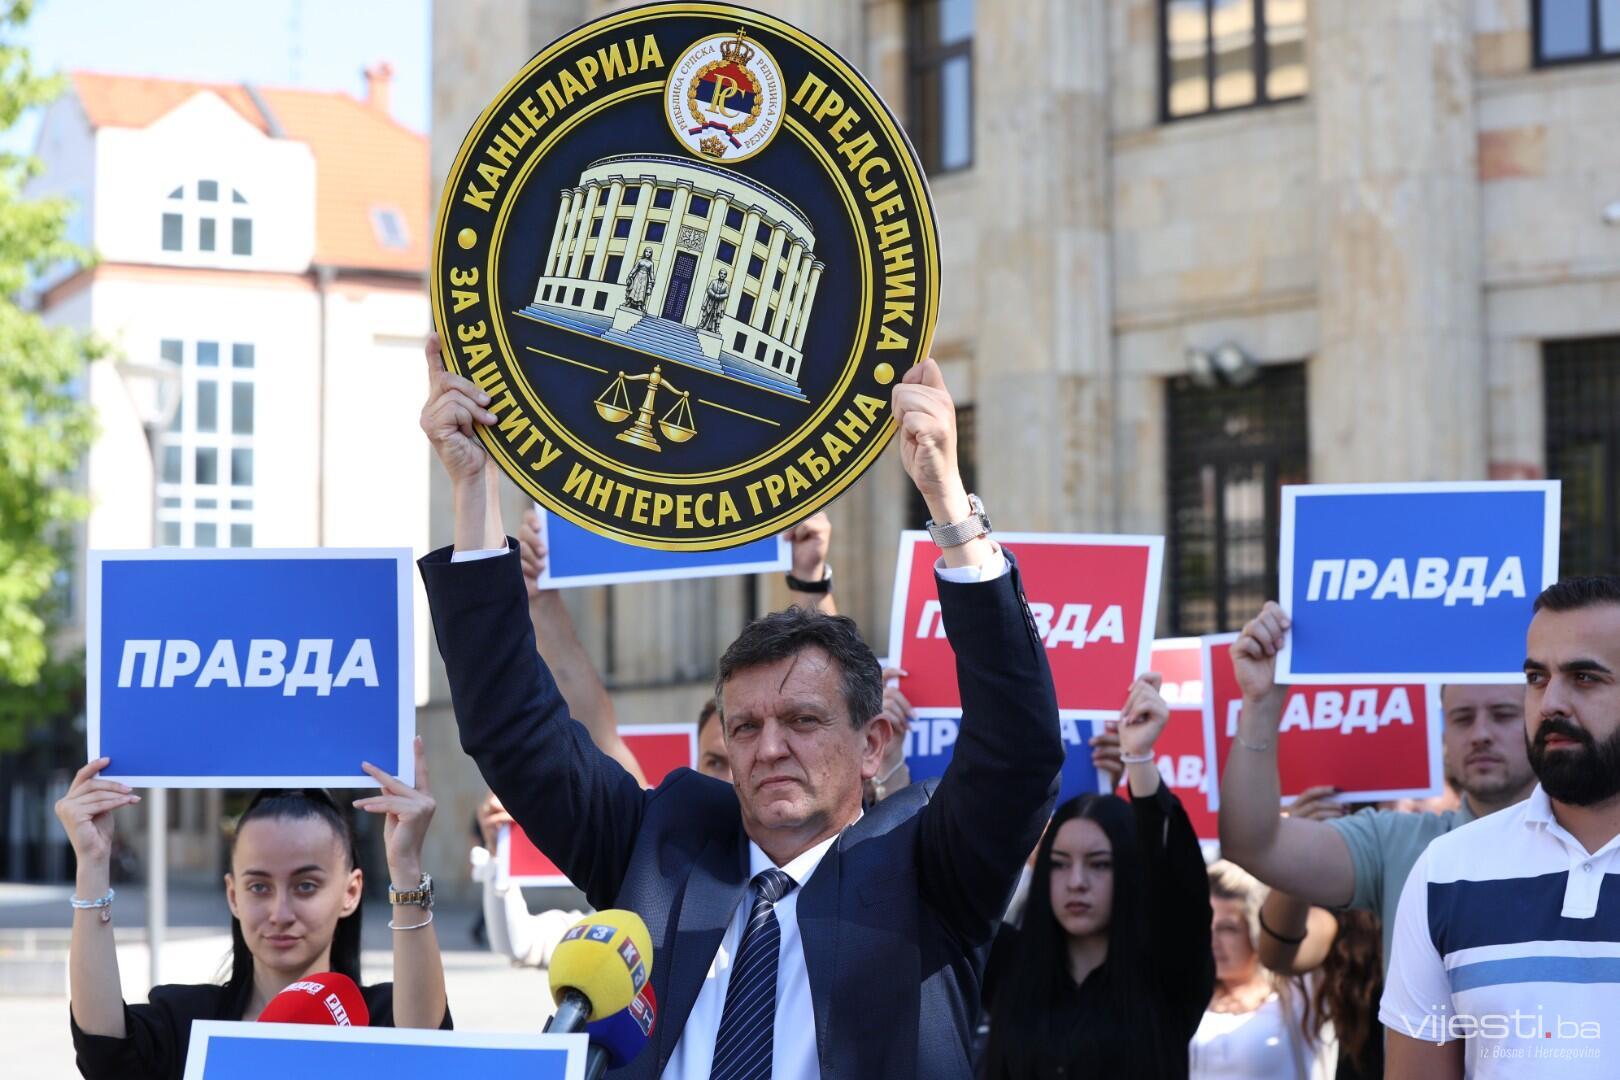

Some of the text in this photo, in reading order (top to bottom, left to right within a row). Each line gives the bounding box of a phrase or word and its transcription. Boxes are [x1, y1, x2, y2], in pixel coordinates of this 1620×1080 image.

[682, 45, 716, 75] СРПСКА
[463, 34, 915, 350] КАНЦЕЛАРИЈА ПРЕДСЈЕДНИКА
[450, 266, 887, 529] ЗА ЗАШТИТУ ИНТЕРЕСА ГРАЂАНА
[1306, 556, 1527, 607] ПРАВДА
[916, 600, 1125, 649] ПВДА
[117, 638, 379, 696] ПРАВДА
